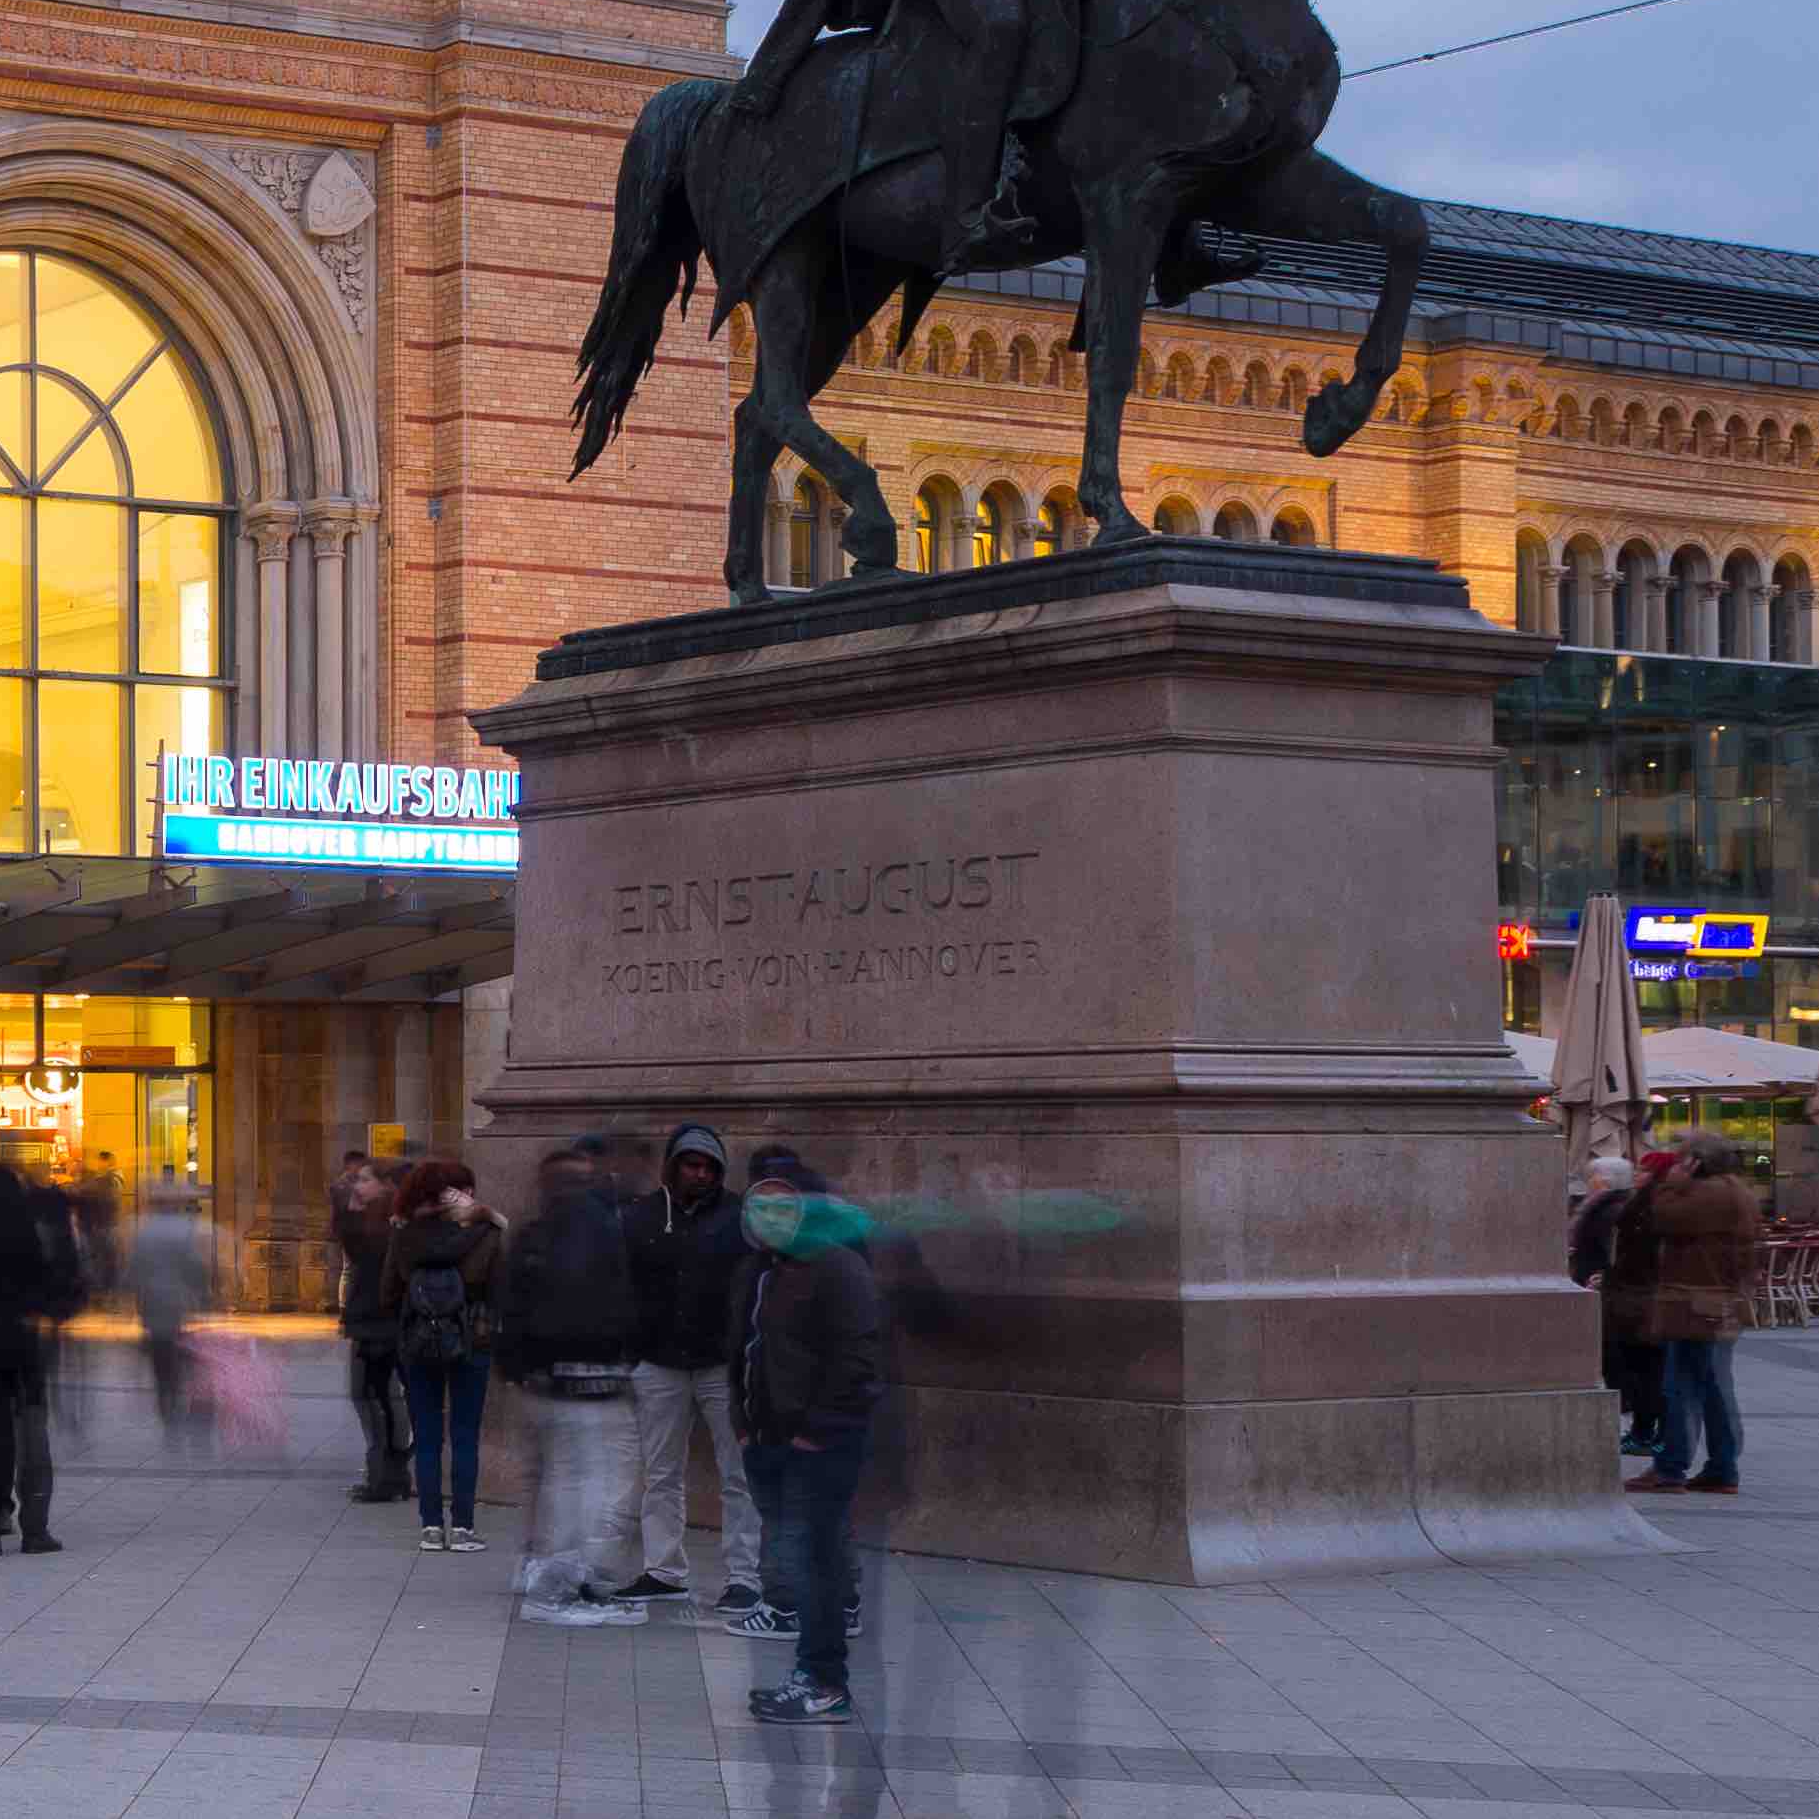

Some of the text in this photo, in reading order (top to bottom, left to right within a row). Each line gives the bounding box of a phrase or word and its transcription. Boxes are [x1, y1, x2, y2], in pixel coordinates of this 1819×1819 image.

[164, 755, 236, 807] IHR
[797, 852, 1040, 923] AUGUST
[602, 940, 1051, 996] KOENIG VON HANNOVER
